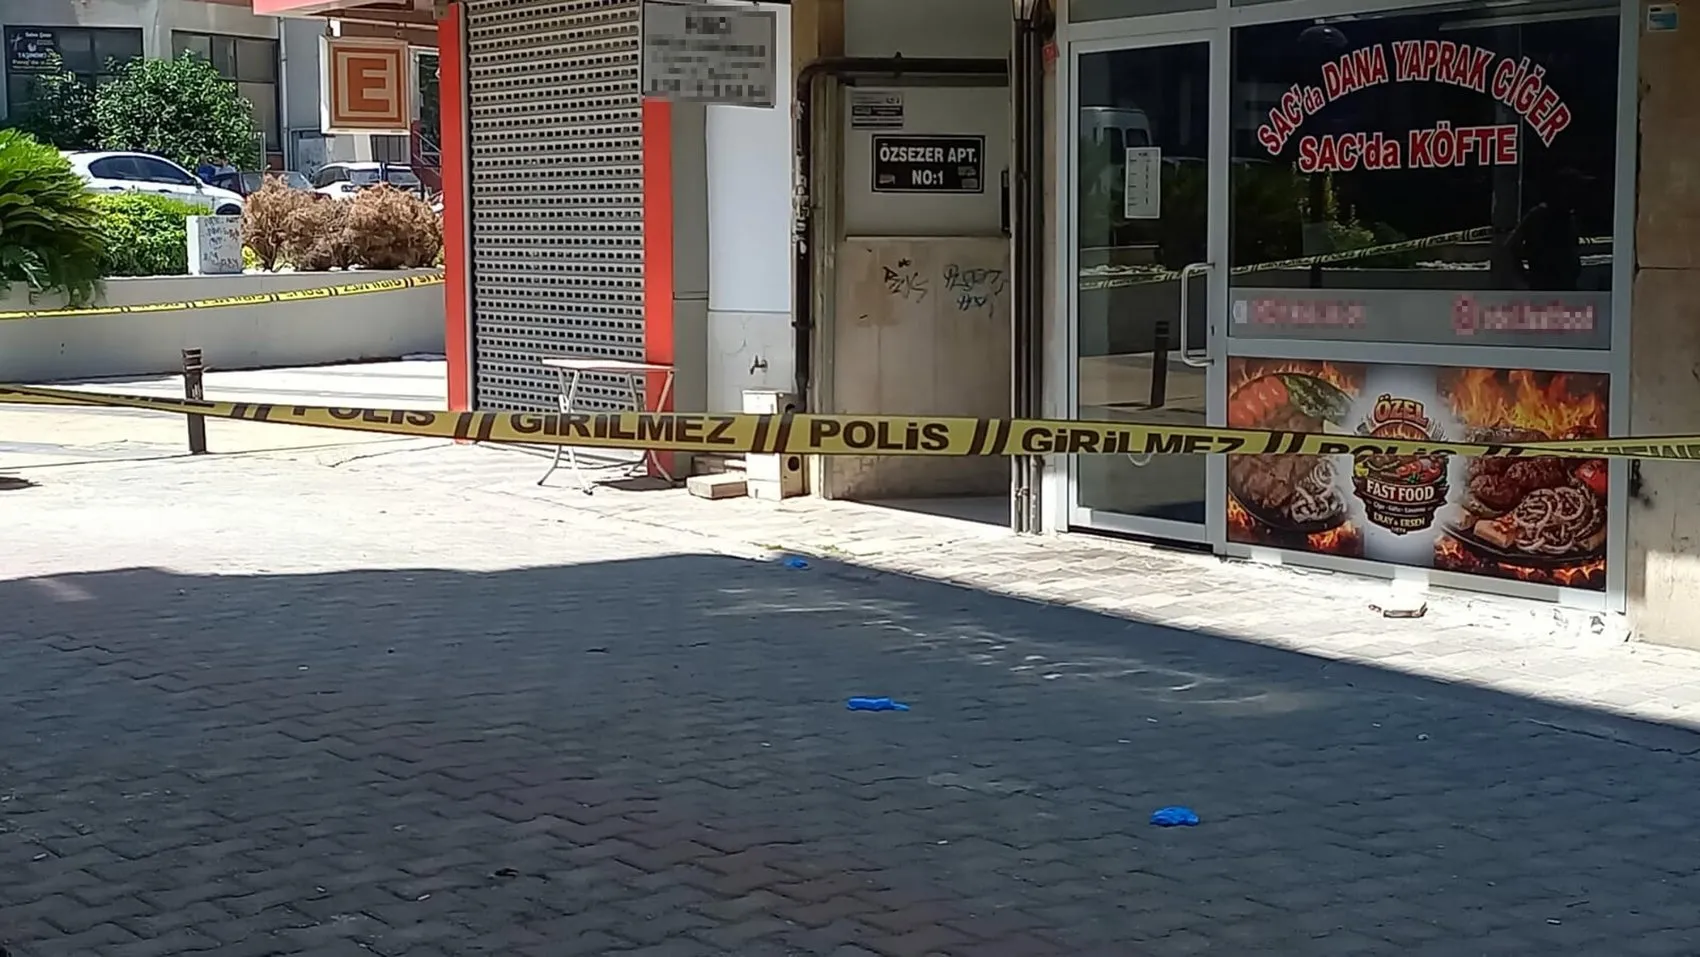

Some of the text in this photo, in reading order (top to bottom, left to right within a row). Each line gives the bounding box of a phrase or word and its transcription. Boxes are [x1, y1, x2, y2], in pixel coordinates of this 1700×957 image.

[347, 58, 389, 112] E
[1322, 43, 1388, 102] DANA
[1392, 40, 1495, 92] YAPRAK
[879, 143, 977, 163] ÖZSEZER APT.
[1408, 120, 1519, 168] KÖFTE
[911, 169, 944, 185] NO:1
[1374, 393, 1429, 428] ÖZEL
[1366, 479, 1434, 502] FAST FOOD
